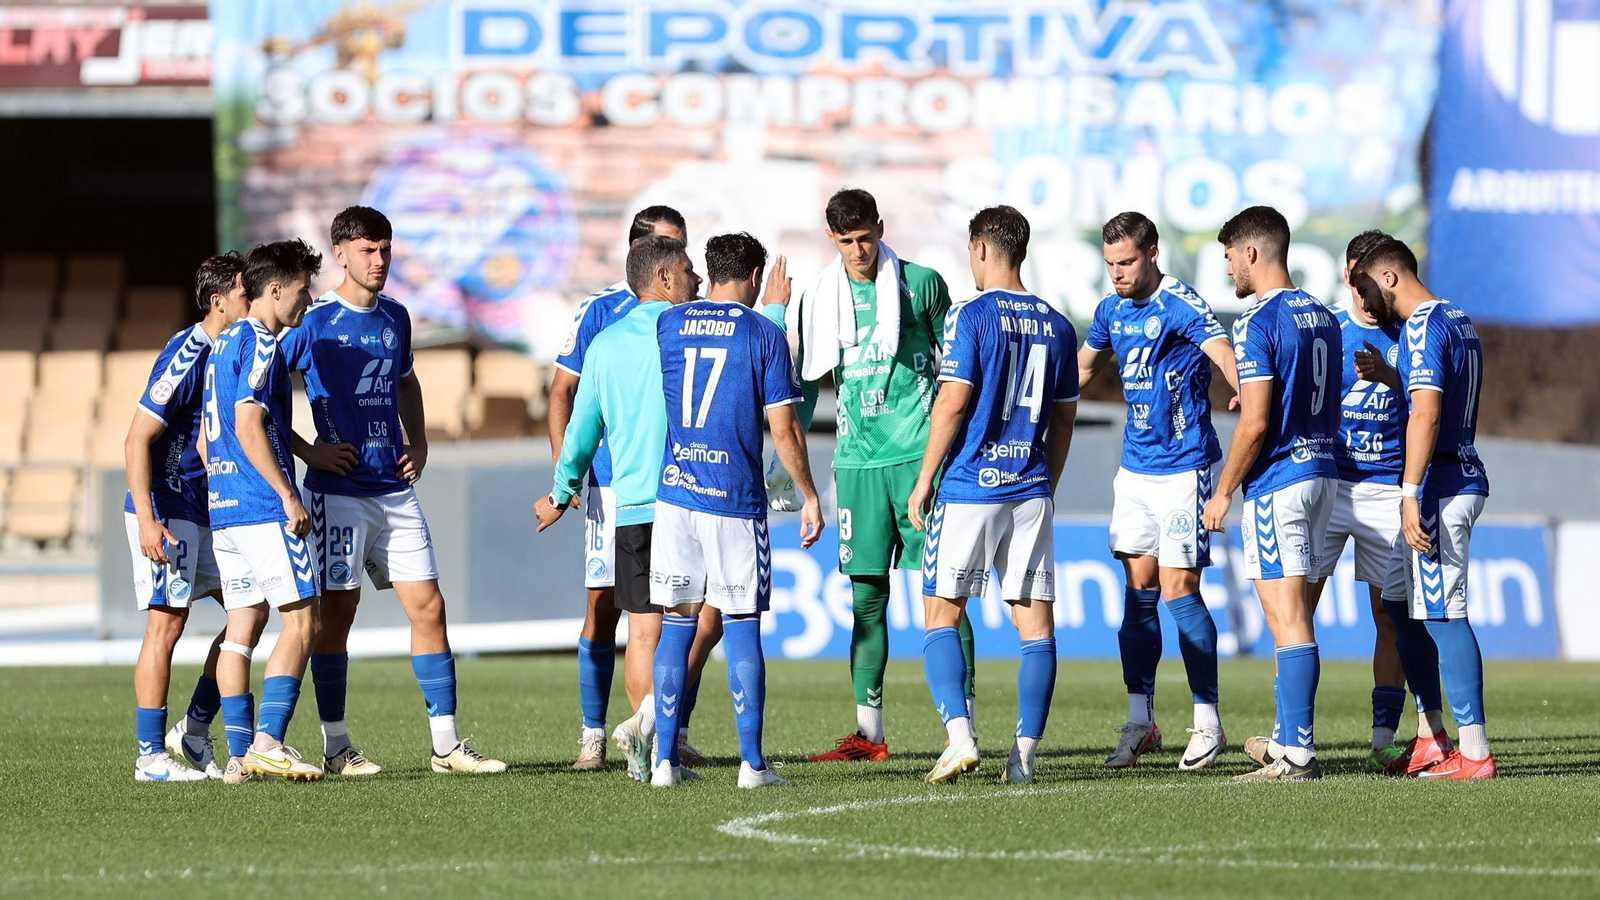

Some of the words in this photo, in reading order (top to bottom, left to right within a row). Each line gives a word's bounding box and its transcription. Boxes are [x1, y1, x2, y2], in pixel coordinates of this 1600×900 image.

[460, 7, 1228, 70] DEPORTIVA
[258, 69, 582, 126] SOCIOS
[604, 73, 1386, 137] COMPROMISARIOS
[943, 154, 1308, 233] SOMOS
[684, 307, 725, 317] indeso
[996, 297, 1034, 312] indeso
[679, 319, 736, 337] JACOBO
[1043, 321, 1056, 338] M.
[844, 364, 891, 380] oneair.es
[1311, 337, 1328, 416] 9
[373, 377, 393, 393] Air
[683, 347, 728, 428] 17
[1002, 341, 1047, 423] 14
[358, 395, 392, 407] oneair.es
[860, 389, 885, 407] L3G
[1363, 392, 1394, 410] Air
[1343, 410, 1389, 421] oneair.es
[368, 421, 388, 437] L3G
[329, 525, 354, 557] 23
